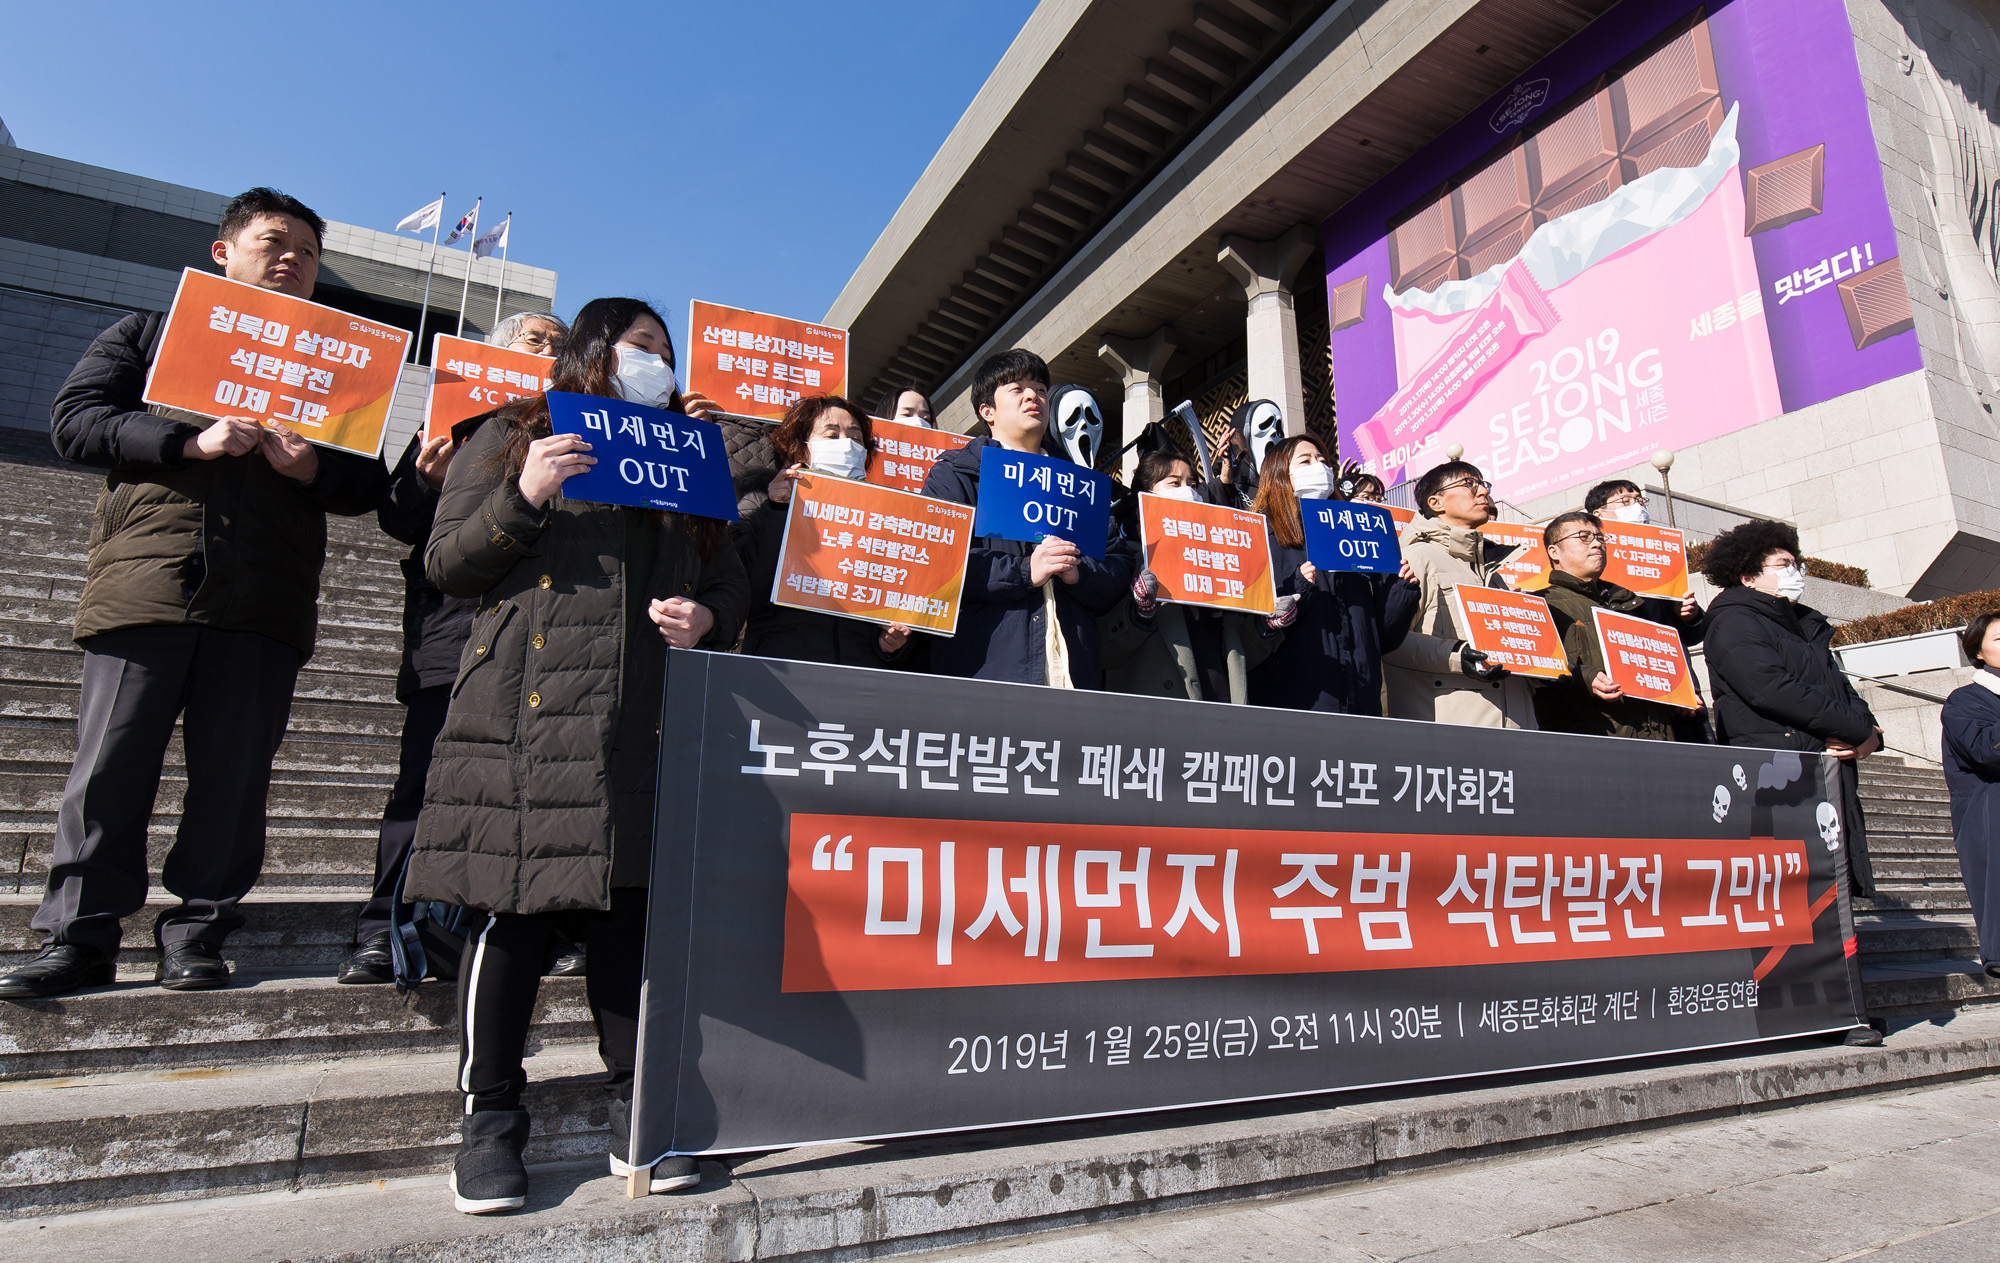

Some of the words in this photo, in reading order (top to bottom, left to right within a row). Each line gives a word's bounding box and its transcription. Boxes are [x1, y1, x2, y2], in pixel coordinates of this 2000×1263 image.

[1499, 90, 1540, 122] SEJONG
[1689, 289, 1764, 341] 세종을
[1774, 242, 1874, 306] 맛보다!
[209, 305, 290, 347] 침묵의
[295, 328, 372, 370] 살인자
[702, 325, 834, 366] 산업통상자원부는
[229, 348, 334, 394] 석탄발전
[446, 359, 483, 379] 석탄
[486, 366, 539, 391] 중독에
[717, 353, 768, 379] 탈석탄
[772, 362, 820, 387] 로드맵
[1394, 398, 1429, 436] 2019.1.30(수)
[1428, 382, 1445, 401] 14:00
[1466, 347, 1480, 362] 개별
[1478, 333, 1493, 350] 티켓
[1491, 320, 1506, 337] 오픈
[1399, 380, 1432, 416] 2019.1.17(목)
[1431, 363, 1449, 383] 14:00
[1447, 345, 1466, 367] 패키지
[1464, 332, 1479, 349] 티켓
[1477, 320, 1492, 336] 오픈
[1528, 328, 1620, 397] 2019
[735, 382, 800, 407] 수립하라
[1410, 396, 1445, 433] 2019.1.31(목)
[1444, 379, 1462, 399] 14:00
[1461, 367, 1475, 381] 개별
[1473, 354, 1487, 370] 티켓
[1486, 341, 1500, 358] 오픈
[1488, 348, 1664, 447] SEJONG
[1635, 383, 1664, 410] 세종
[214, 379, 270, 414] 이제
[273, 394, 329, 428] 그만
[1637, 402, 1668, 428] 시즌
[581, 409, 706, 459] 미세먼지
[1472, 398, 1632, 484] SEASON
[1382, 431, 1441, 472] 테이스트
[1588, 442, 1659, 471] www.sejongpac.or.kr
[619, 458, 689, 493] OUT
[883, 460, 925, 482] 탈석탄
[1003, 461, 1095, 506] 미세먼지
[802, 499, 864, 527] 미세먼지
[868, 512, 955, 546] 감축한다면서
[1023, 501, 1078, 531] OUT
[1318, 508, 1387, 535] 미세먼지
[821, 528, 854, 548] 노후
[857, 535, 930, 566] 석탄발전소
[1162, 517, 1206, 542] 침묵의
[1209, 525, 1252, 549] 살인자
[1339, 539, 1379, 559] OUT
[1504, 535, 1538, 547] 미세먼지
[1604, 533, 1617, 544] 탄
[1619, 534, 1644, 548] 중독에
[1645, 538, 1662, 550] 빠진
[1663, 541, 1680, 553] 한국
[837, 556, 909, 586] 수명연장?
[1182, 547, 1240, 573] 석탄발전
[1627, 564, 1661, 579] 불러온다
[1629, 550, 1671, 566] 지구온난화
[786, 572, 848, 600] 석탄발전
[851, 584, 881, 606] 조기
[884, 589, 949, 619] 폐쇄하라!
[1184, 573, 1213, 595] 이제
[1215, 578, 1244, 599] 그만
[1466, 600, 1500, 616] 미세먼지
[1500, 605, 1546, 623] 감축한다면서
[1484, 618, 1502, 631] 노후
[1503, 620, 1542, 637] 석탄발전소
[1500, 636, 1537, 652] 수명연장?
[1607, 629, 1678, 657] 산업통상자원부는
[1514, 653, 1532, 666] 조기
[1532, 655, 1566, 671] 폐쇄하라!
[1619, 649, 1648, 668] 탈석탄
[1648, 656, 1676, 675] 로드맵
[1635, 672, 1671, 692] 수립하라
[1078, 744, 1165, 802] 폐쇄
[1182, 751, 1296, 806] 캠페인
[1310, 759, 1379, 808] 선포
[1393, 764, 1515, 815] 기자회견
[812, 834, 1241, 965] “미세먼지
[1269, 851, 1413, 955] 주범
[1437, 852, 1665, 948] 석탄발전
[1681, 852, 1801, 933] 그만!”
[947, 1029, 1068, 1075] 2019년
[1085, 1024, 1133, 1066] 1월
[1143, 1015, 1258, 1060] 25일(금)
[1267, 1012, 1319, 1051] 오전
[1327, 1008, 1382, 1044] 11시
[1390, 1004, 1442, 1040] 30분
[1478, 992, 1597, 1034] 세종문화회관
[1603, 989, 1639, 1020] 계단
[1667, 979, 1759, 1016] 환경운동연합
